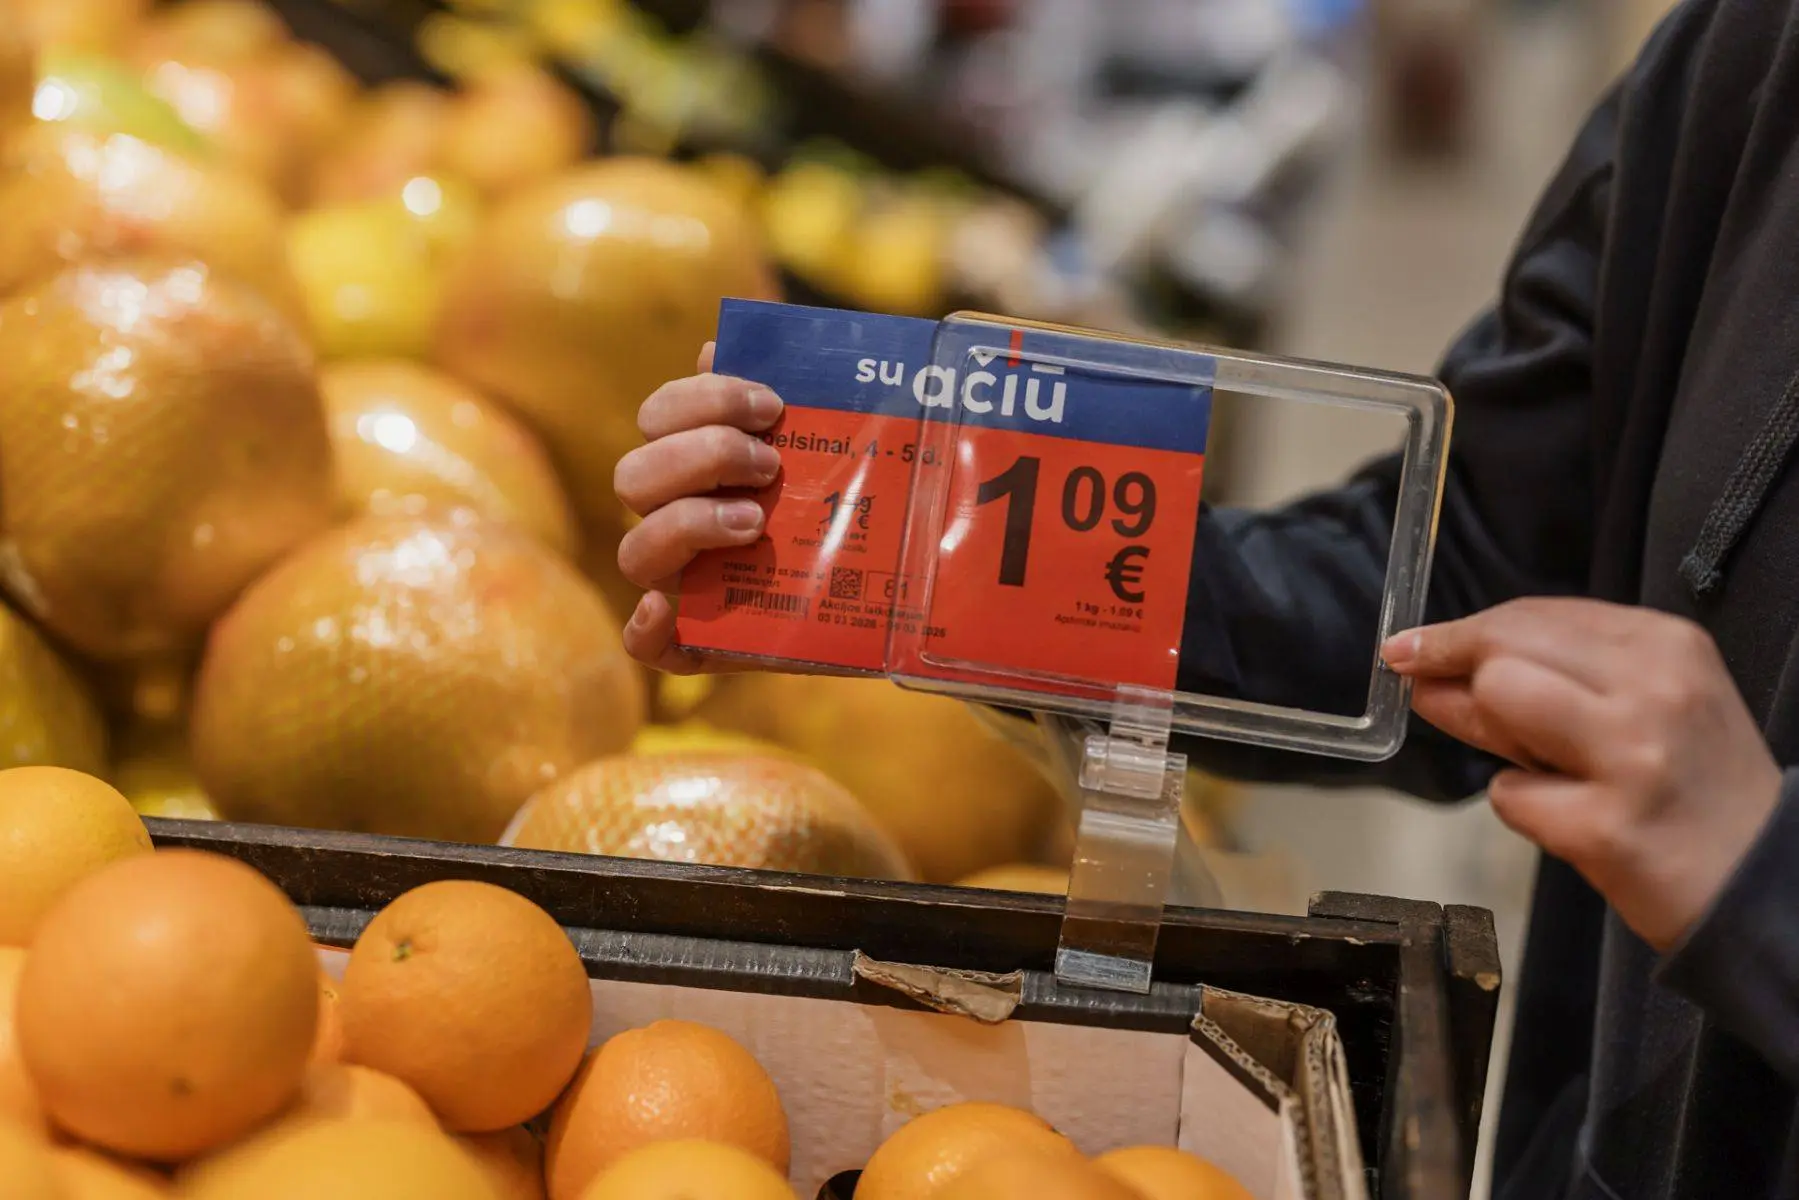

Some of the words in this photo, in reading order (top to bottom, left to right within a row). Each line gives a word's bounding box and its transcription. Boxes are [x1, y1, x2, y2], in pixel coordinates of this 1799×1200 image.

[855, 357, 904, 386] su
[912, 331, 1067, 423] ačiū
[759, 430, 856, 459] pelsinai,
[865, 440, 878, 459] 4
[901, 444, 915, 463] 5
[976, 455, 1041, 587] 1
[1061, 465, 1157, 538] 09
[883, 579, 909, 600] 81
[1104, 545, 1150, 603] €
